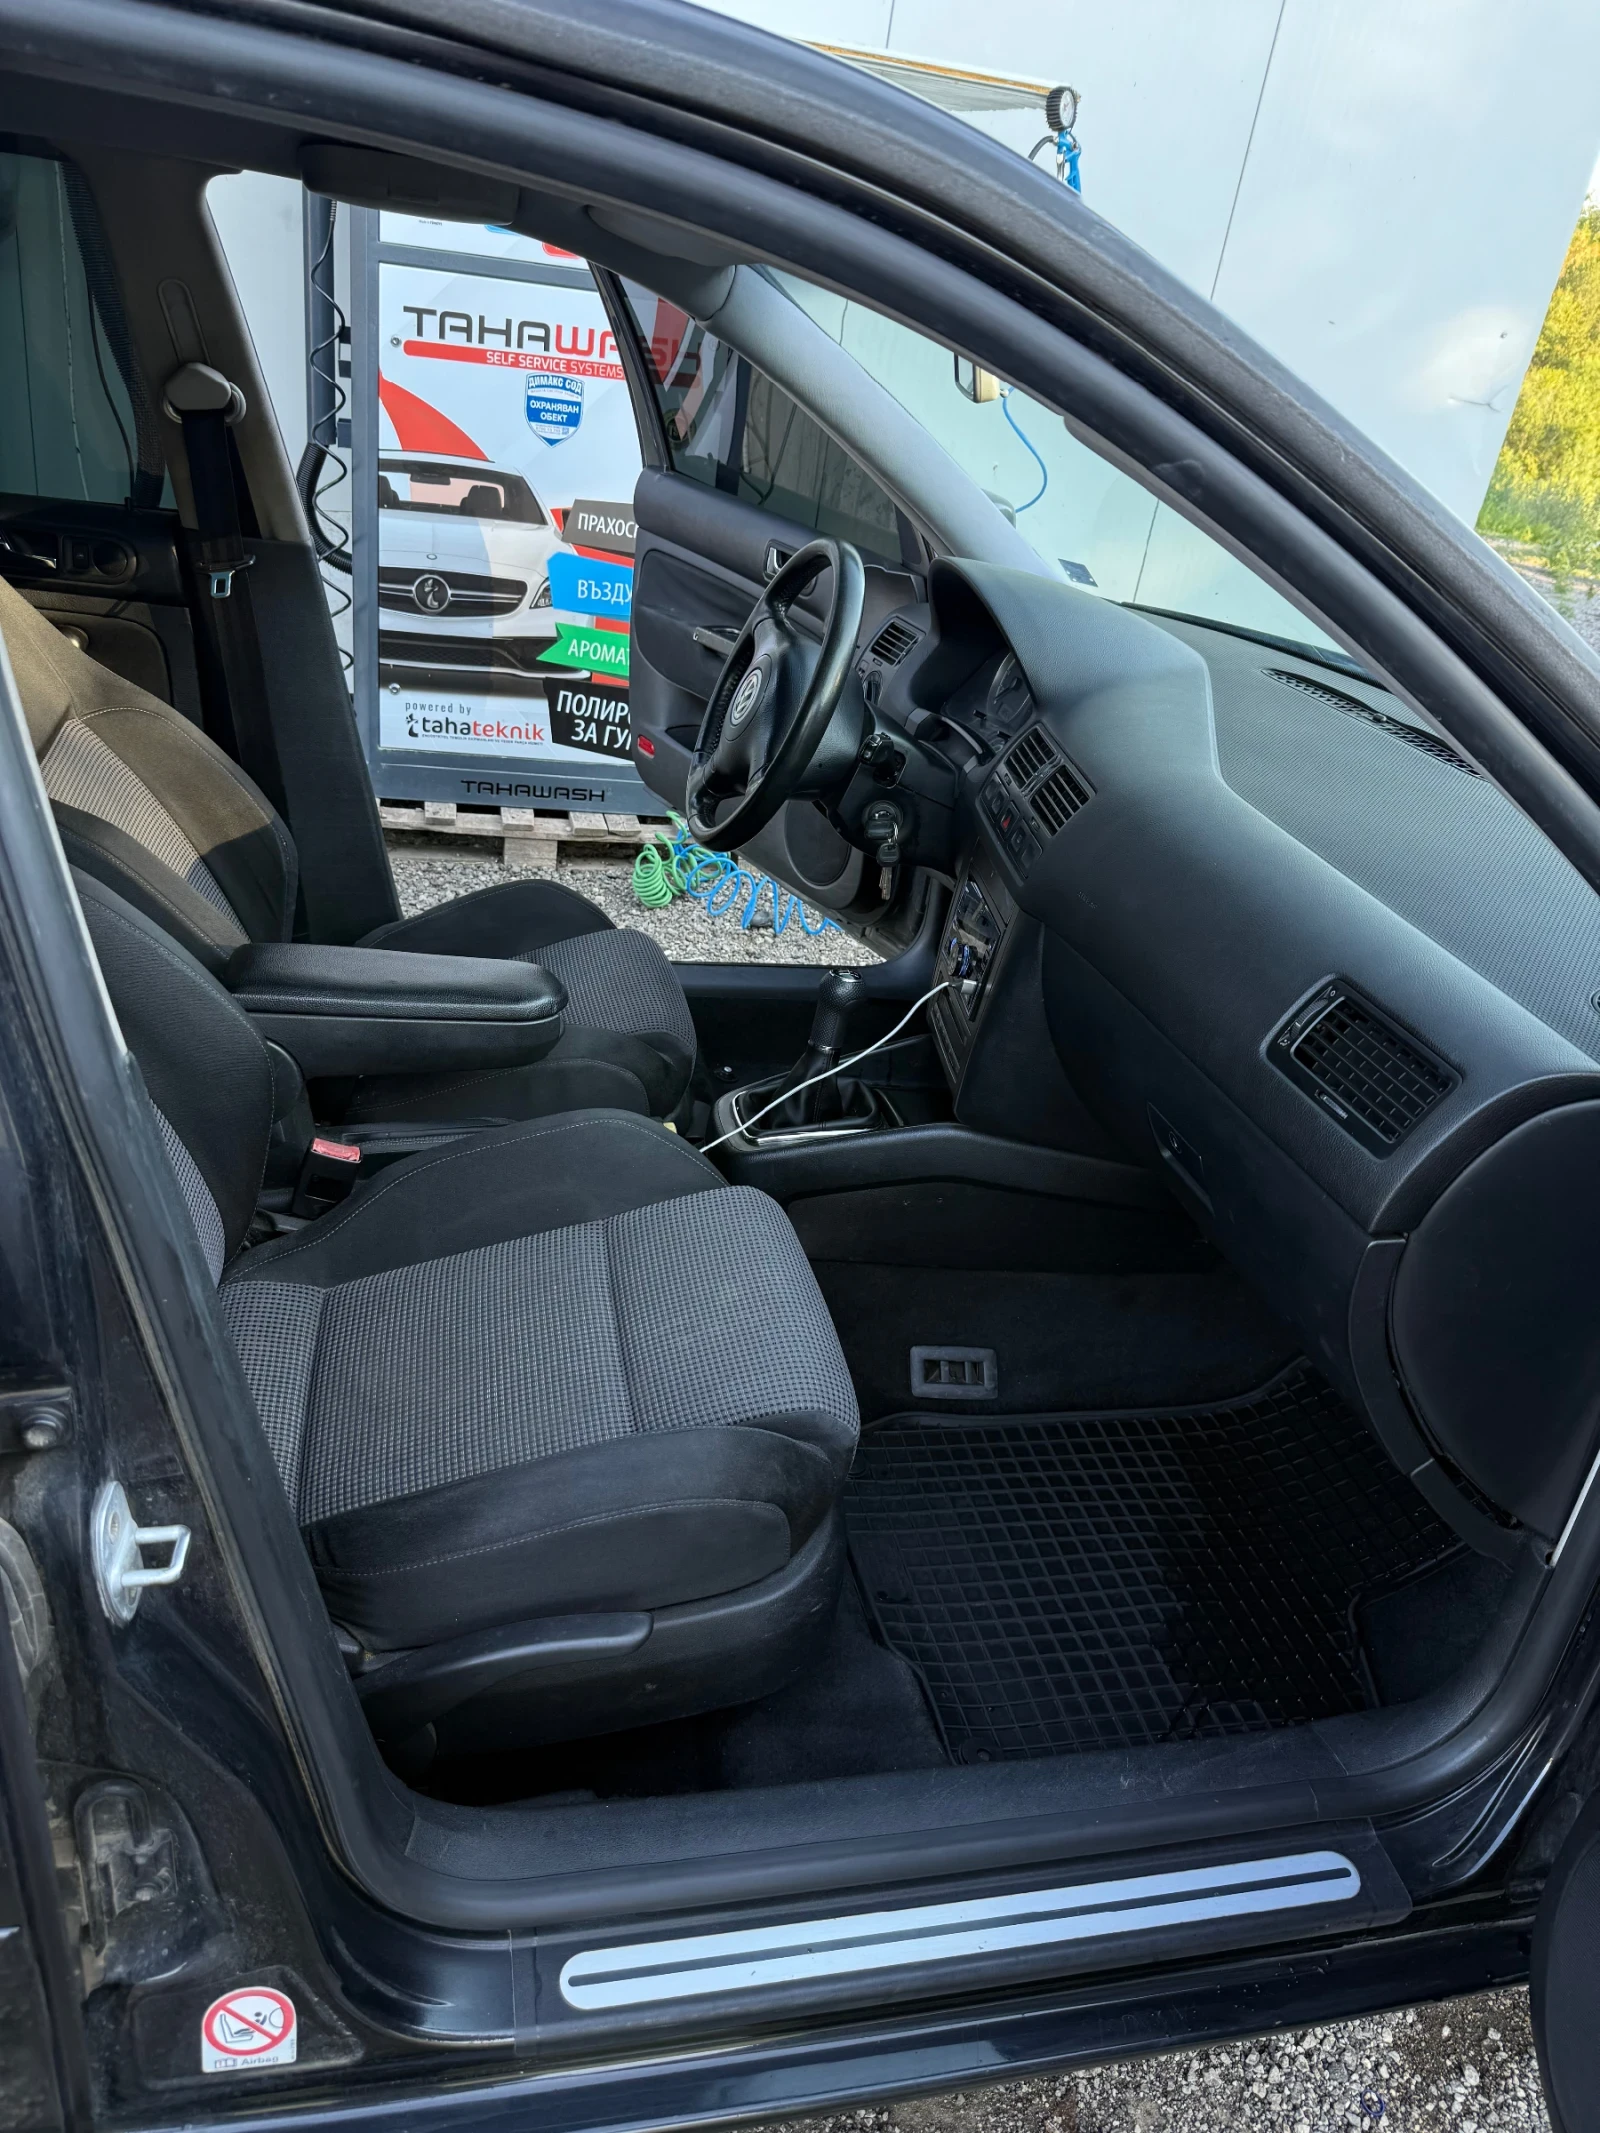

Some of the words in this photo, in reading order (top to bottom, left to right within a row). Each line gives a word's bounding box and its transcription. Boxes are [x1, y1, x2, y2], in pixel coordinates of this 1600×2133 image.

[486, 351, 516, 367] SELF
[518, 356, 567, 373] SERVICE
[570, 362, 624, 379] SYSTEMS
[528, 375, 564, 388] ДИМАКС
[565, 379, 582, 395] СОД
[529, 399, 580, 414] ОХРАНЯВАН
[540, 411, 568, 423] ОБЕКТ
[405, 702, 454, 713] powered
[459, 704, 472, 716] by
[556, 689, 631, 725] ПОЛИР
[422, 716, 545, 742] tahateknik
[570, 719, 598, 745] ЗА
[460, 779, 606, 802] TAHAWASH
[241, 2055, 279, 2066] Airbag
